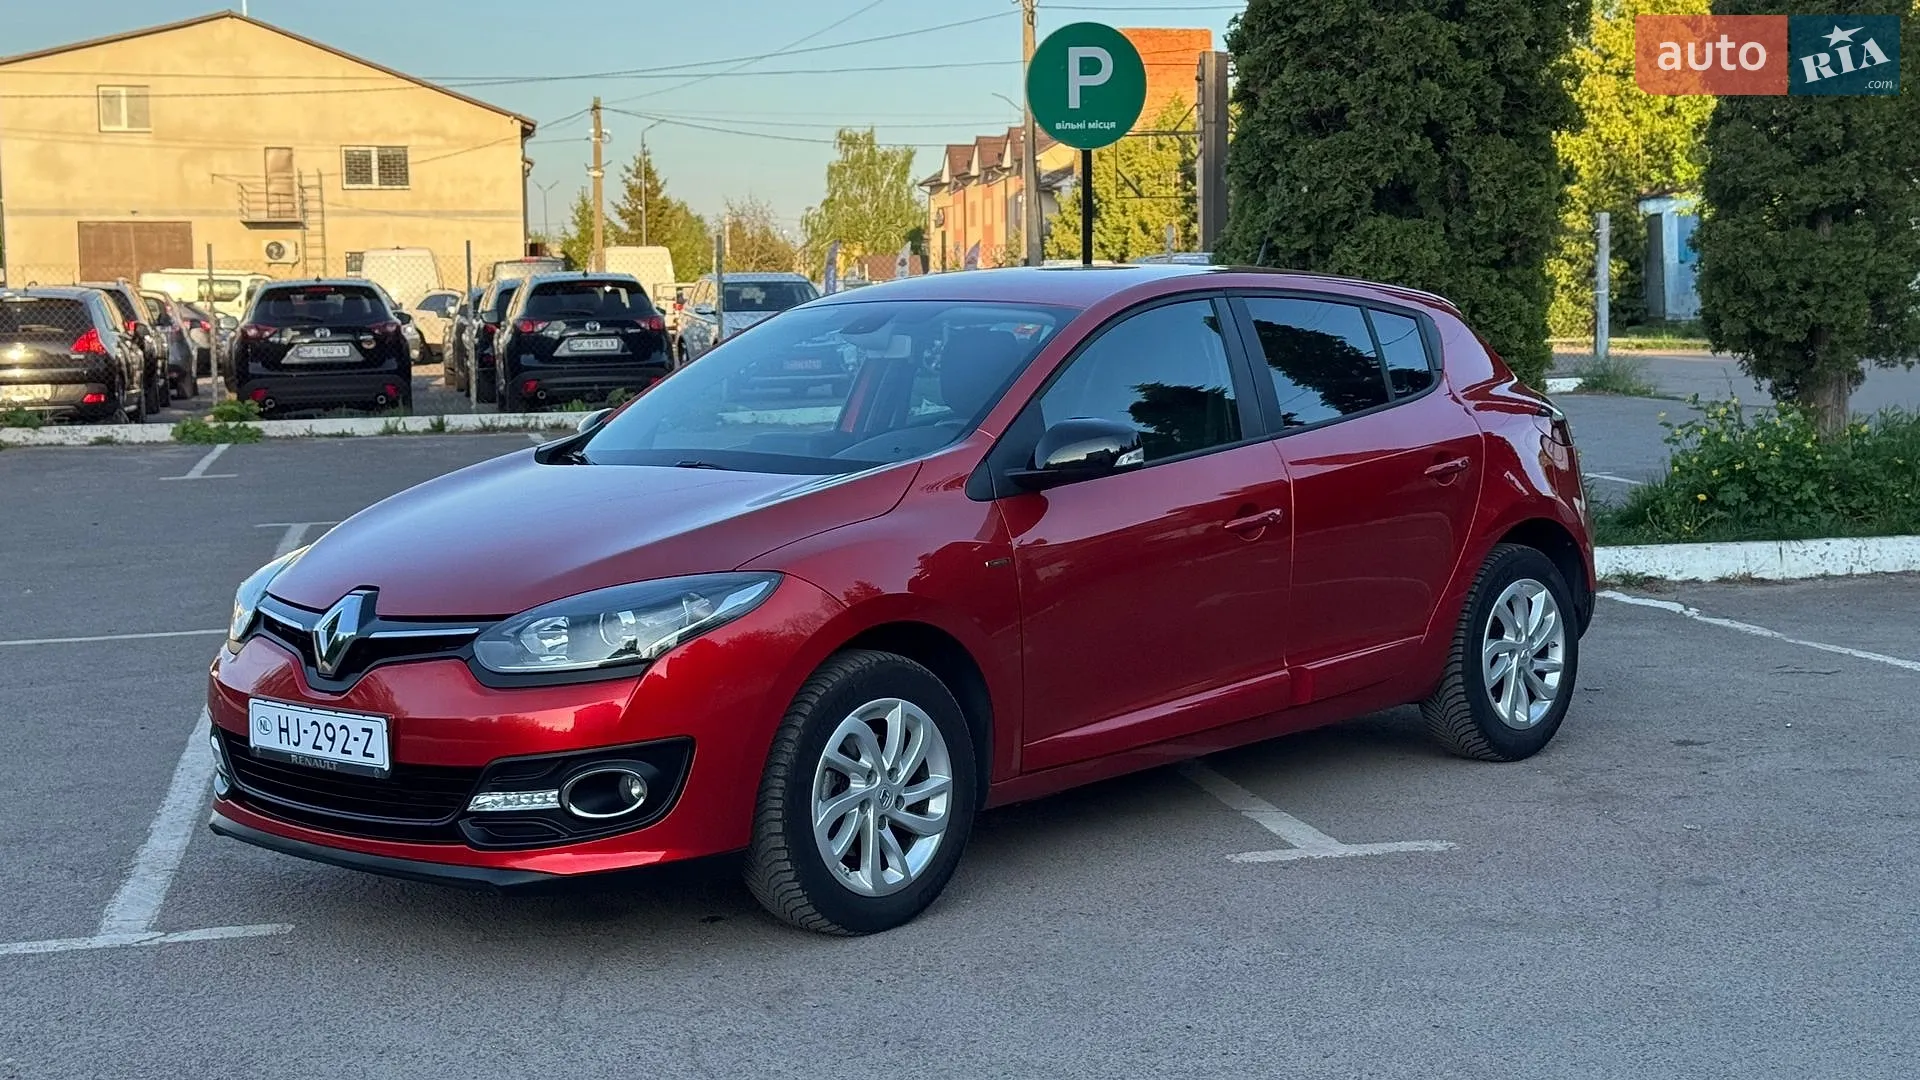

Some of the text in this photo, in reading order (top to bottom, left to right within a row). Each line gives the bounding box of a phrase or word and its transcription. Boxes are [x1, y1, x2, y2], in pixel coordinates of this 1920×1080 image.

[1068, 46, 1114, 109] P
[1055, 120, 1117, 131] вільні місця
[259, 719, 270, 732] NL
[277, 714, 375, 759] HJ-292-Z
[290, 754, 339, 771] RENAULT
